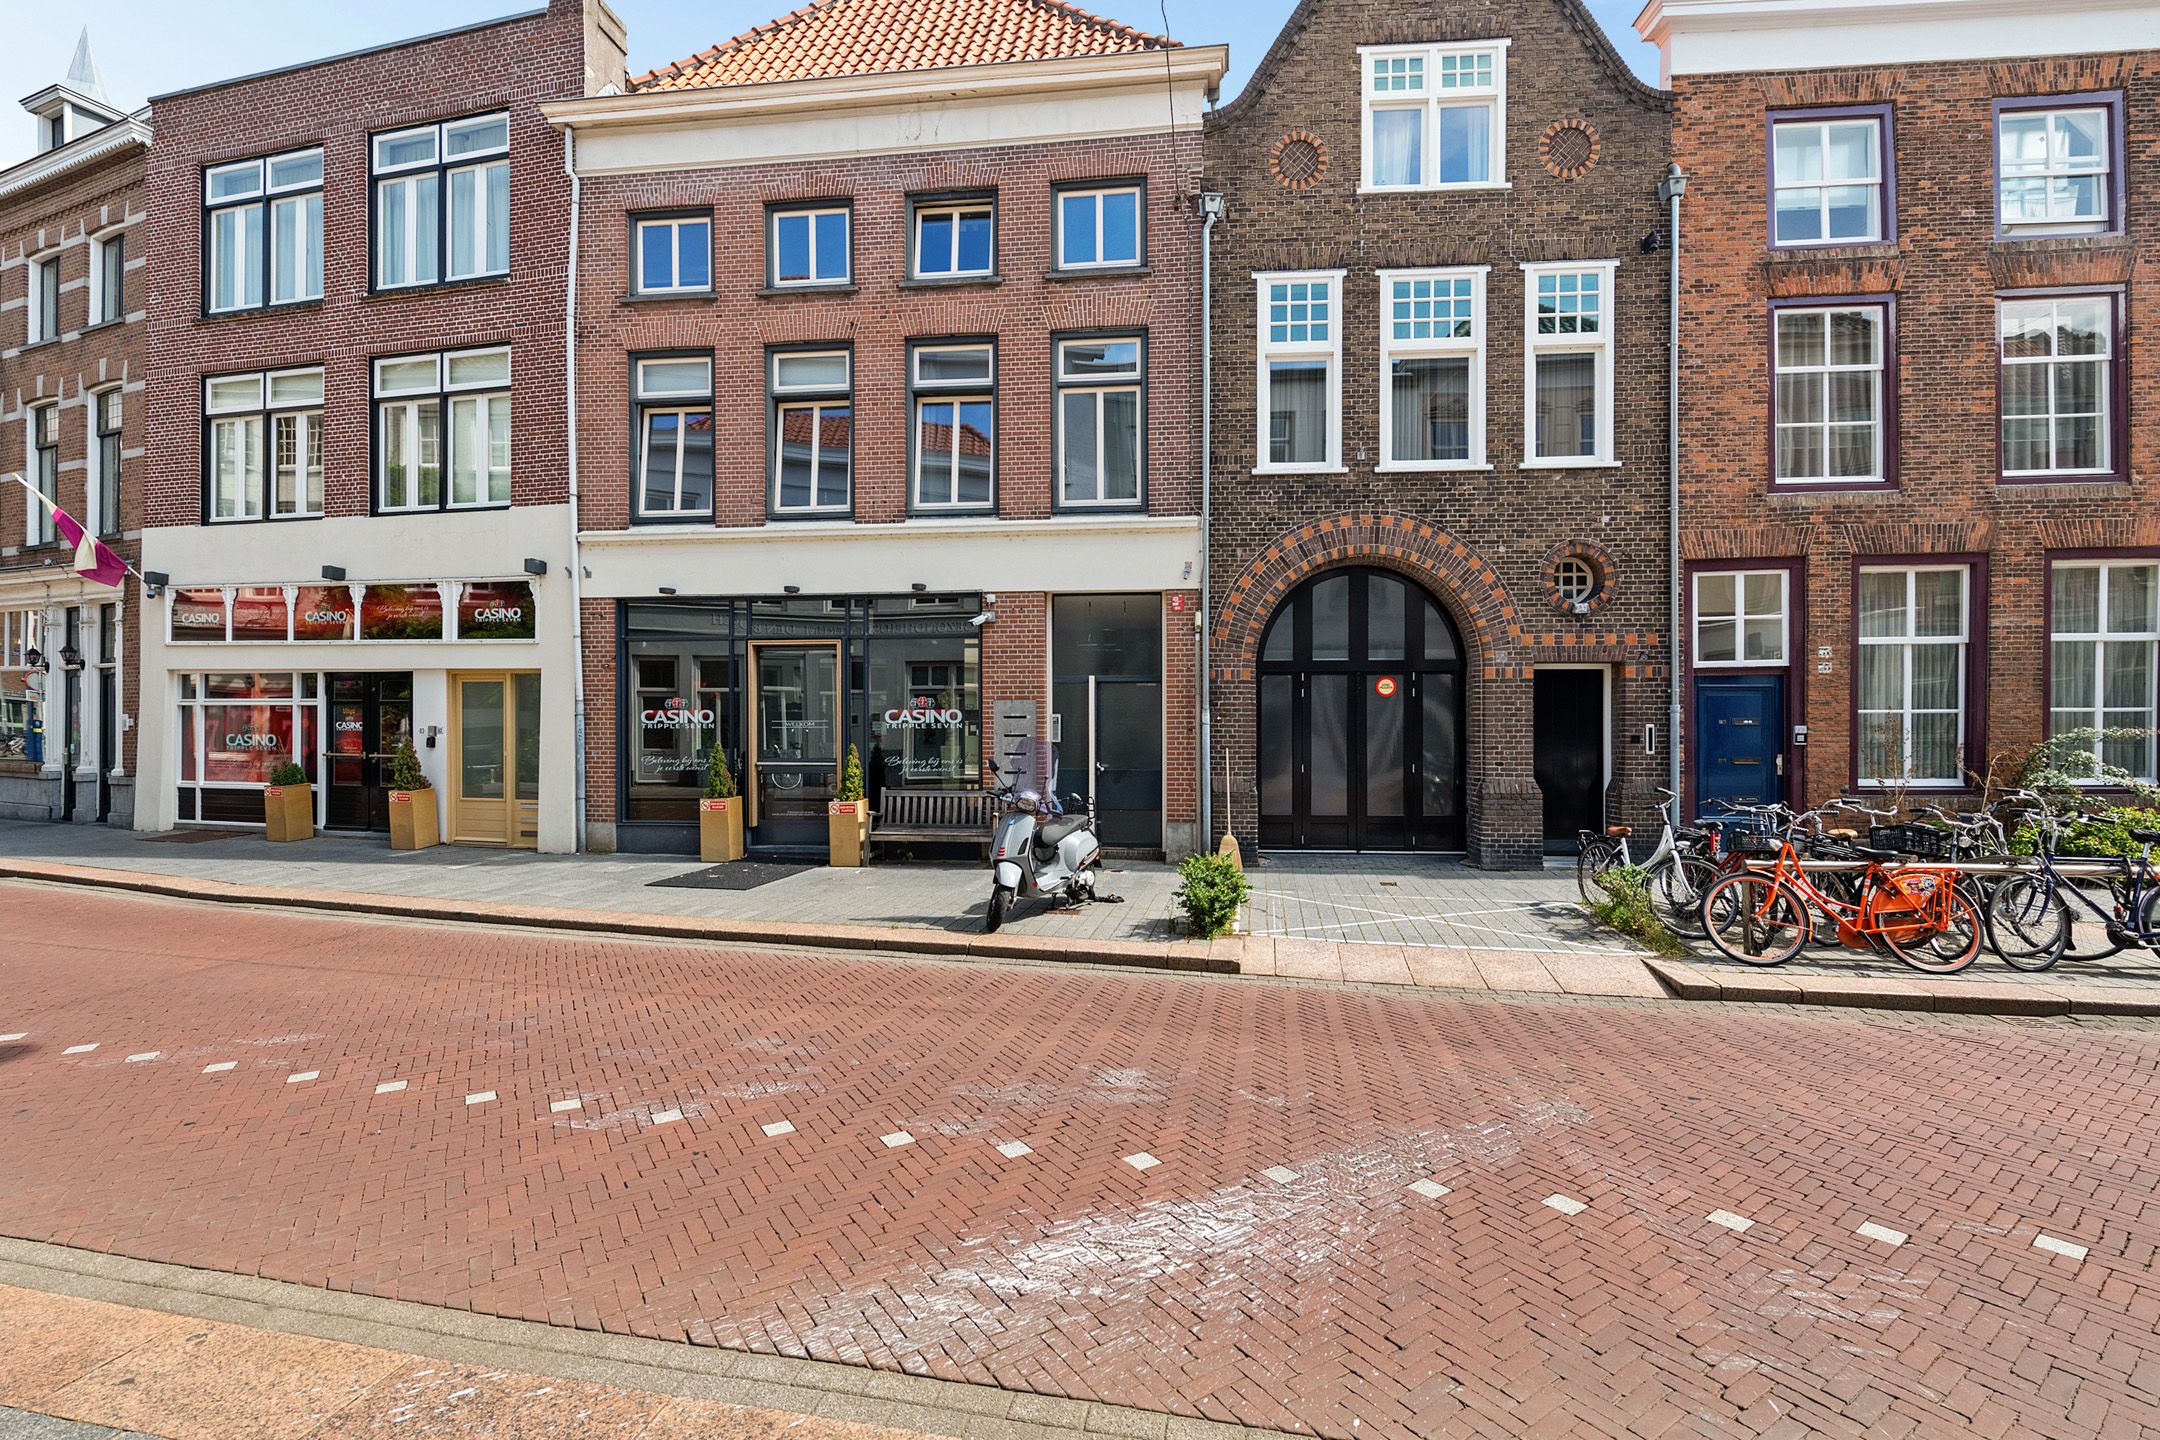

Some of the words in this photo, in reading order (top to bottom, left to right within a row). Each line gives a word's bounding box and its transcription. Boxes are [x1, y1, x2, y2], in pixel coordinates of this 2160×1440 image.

[182, 613, 220, 623] CASINO
[305, 611, 347, 621] CASINO
[474, 608, 522, 619] CASINO
[641, 709, 715, 724] CASINO
[884, 709, 963, 723] CASINO
[226, 733, 277, 746] CASINO
[641, 755, 680, 765] Beleving
[884, 756, 926, 767] Beleving
